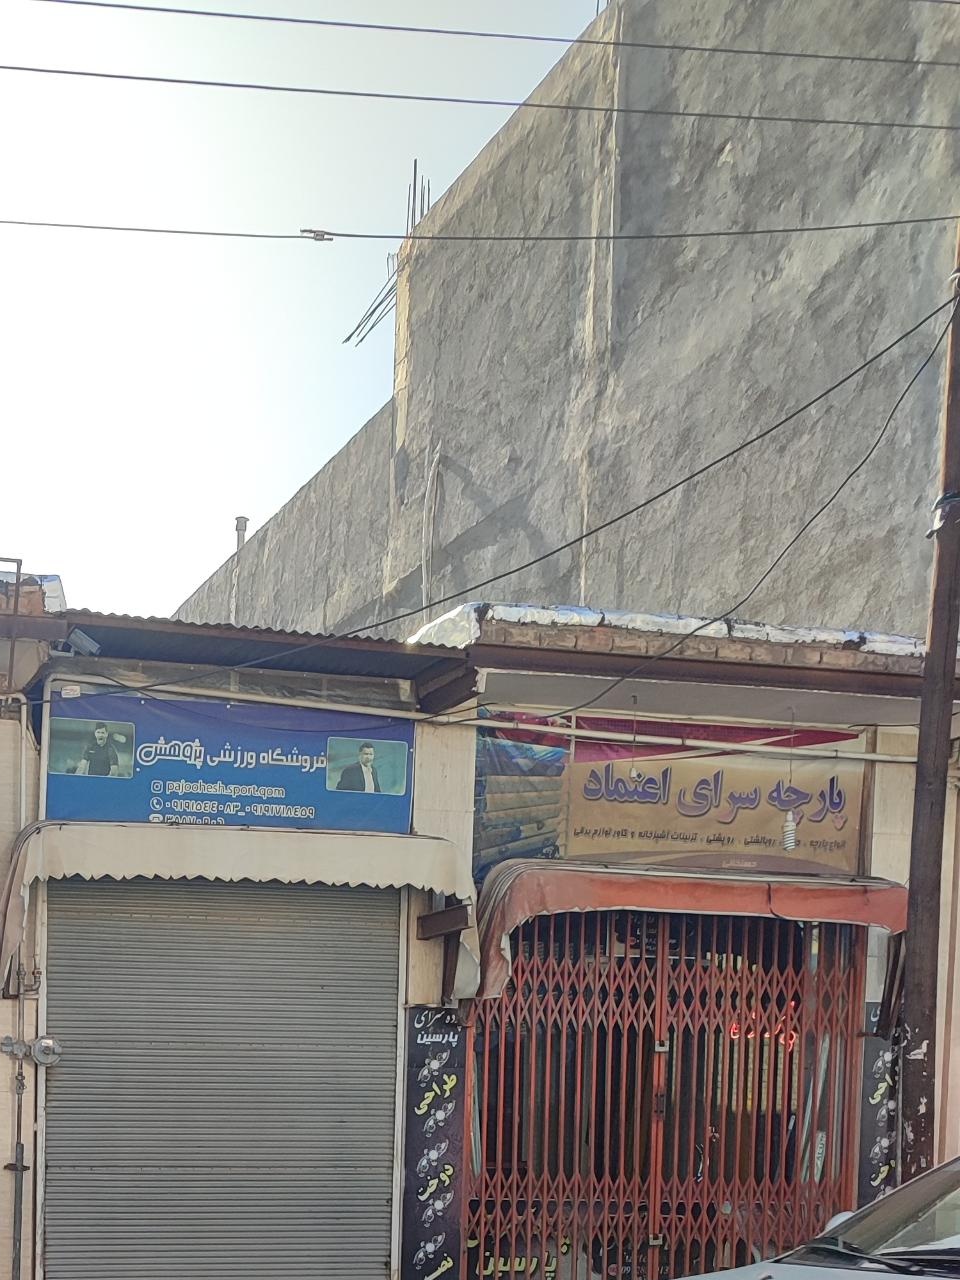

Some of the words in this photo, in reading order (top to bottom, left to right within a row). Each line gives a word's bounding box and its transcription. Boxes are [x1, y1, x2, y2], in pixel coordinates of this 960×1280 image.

[136, 735, 204, 770] پژوهش
[206, 742, 257, 768] ورزشی
[259, 747, 327, 772] فروشگاه
[583, 762, 671, 805] اعتماد
[676, 769, 761, 824] سرای
[767, 775, 849, 831] پارچه
[416, 1031, 459, 1047] پارسین
[414, 1073, 458, 1115] طراحی
[417, 1164, 454, 1201] دوخت
